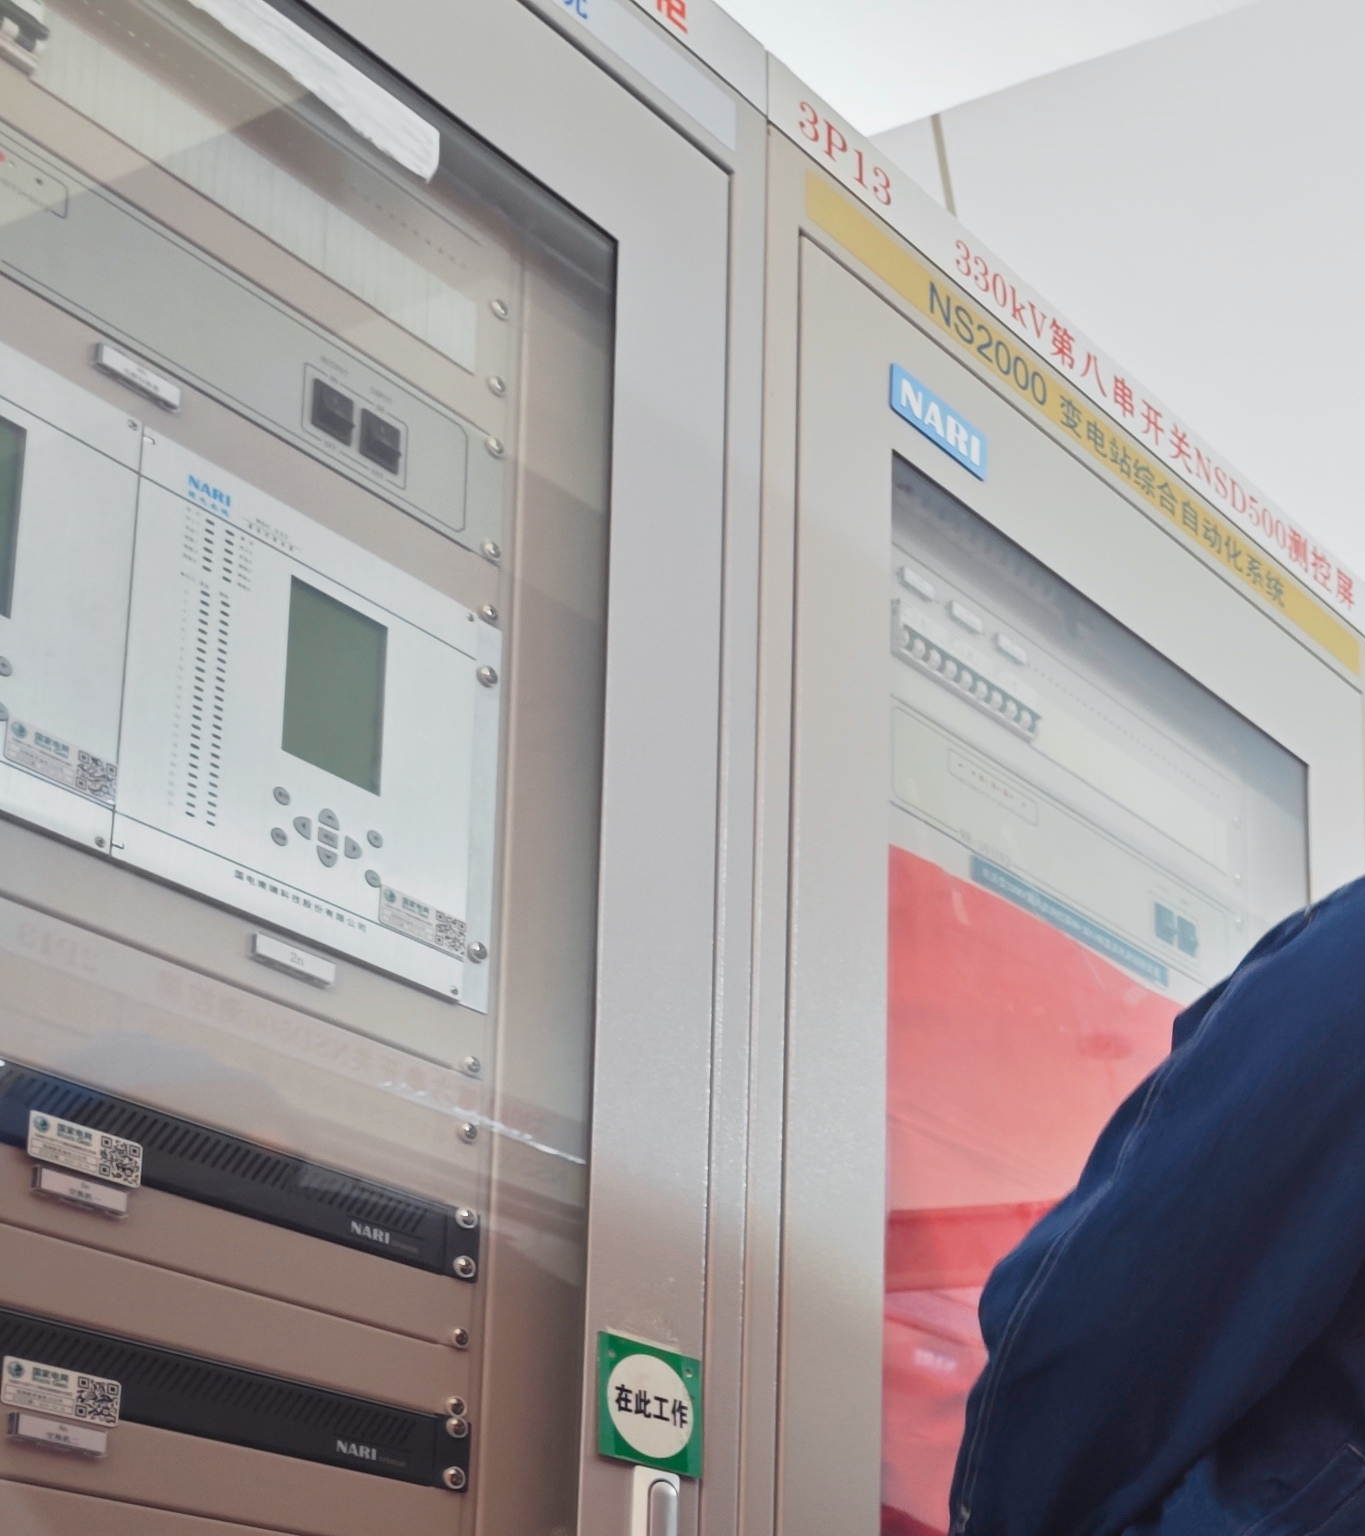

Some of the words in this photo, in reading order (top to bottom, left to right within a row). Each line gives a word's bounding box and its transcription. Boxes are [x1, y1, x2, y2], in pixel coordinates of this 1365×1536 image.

[798, 101, 892, 206] 3P13
[901, 378, 980, 467] NARI
[928, 280, 1047, 406] NS2000
[1059, 394, 1286, 608] 变电站综合自动化系统
[955, 239, 1355, 611] 330kV第八串开关NSD500测控屏
[188, 474, 231, 507] NARI
[289, 951, 305, 968] 2n
[351, 1221, 390, 1244] NARI
[615, 1384, 688, 1428] 在此工作
[336, 1440, 377, 1461] NARI
